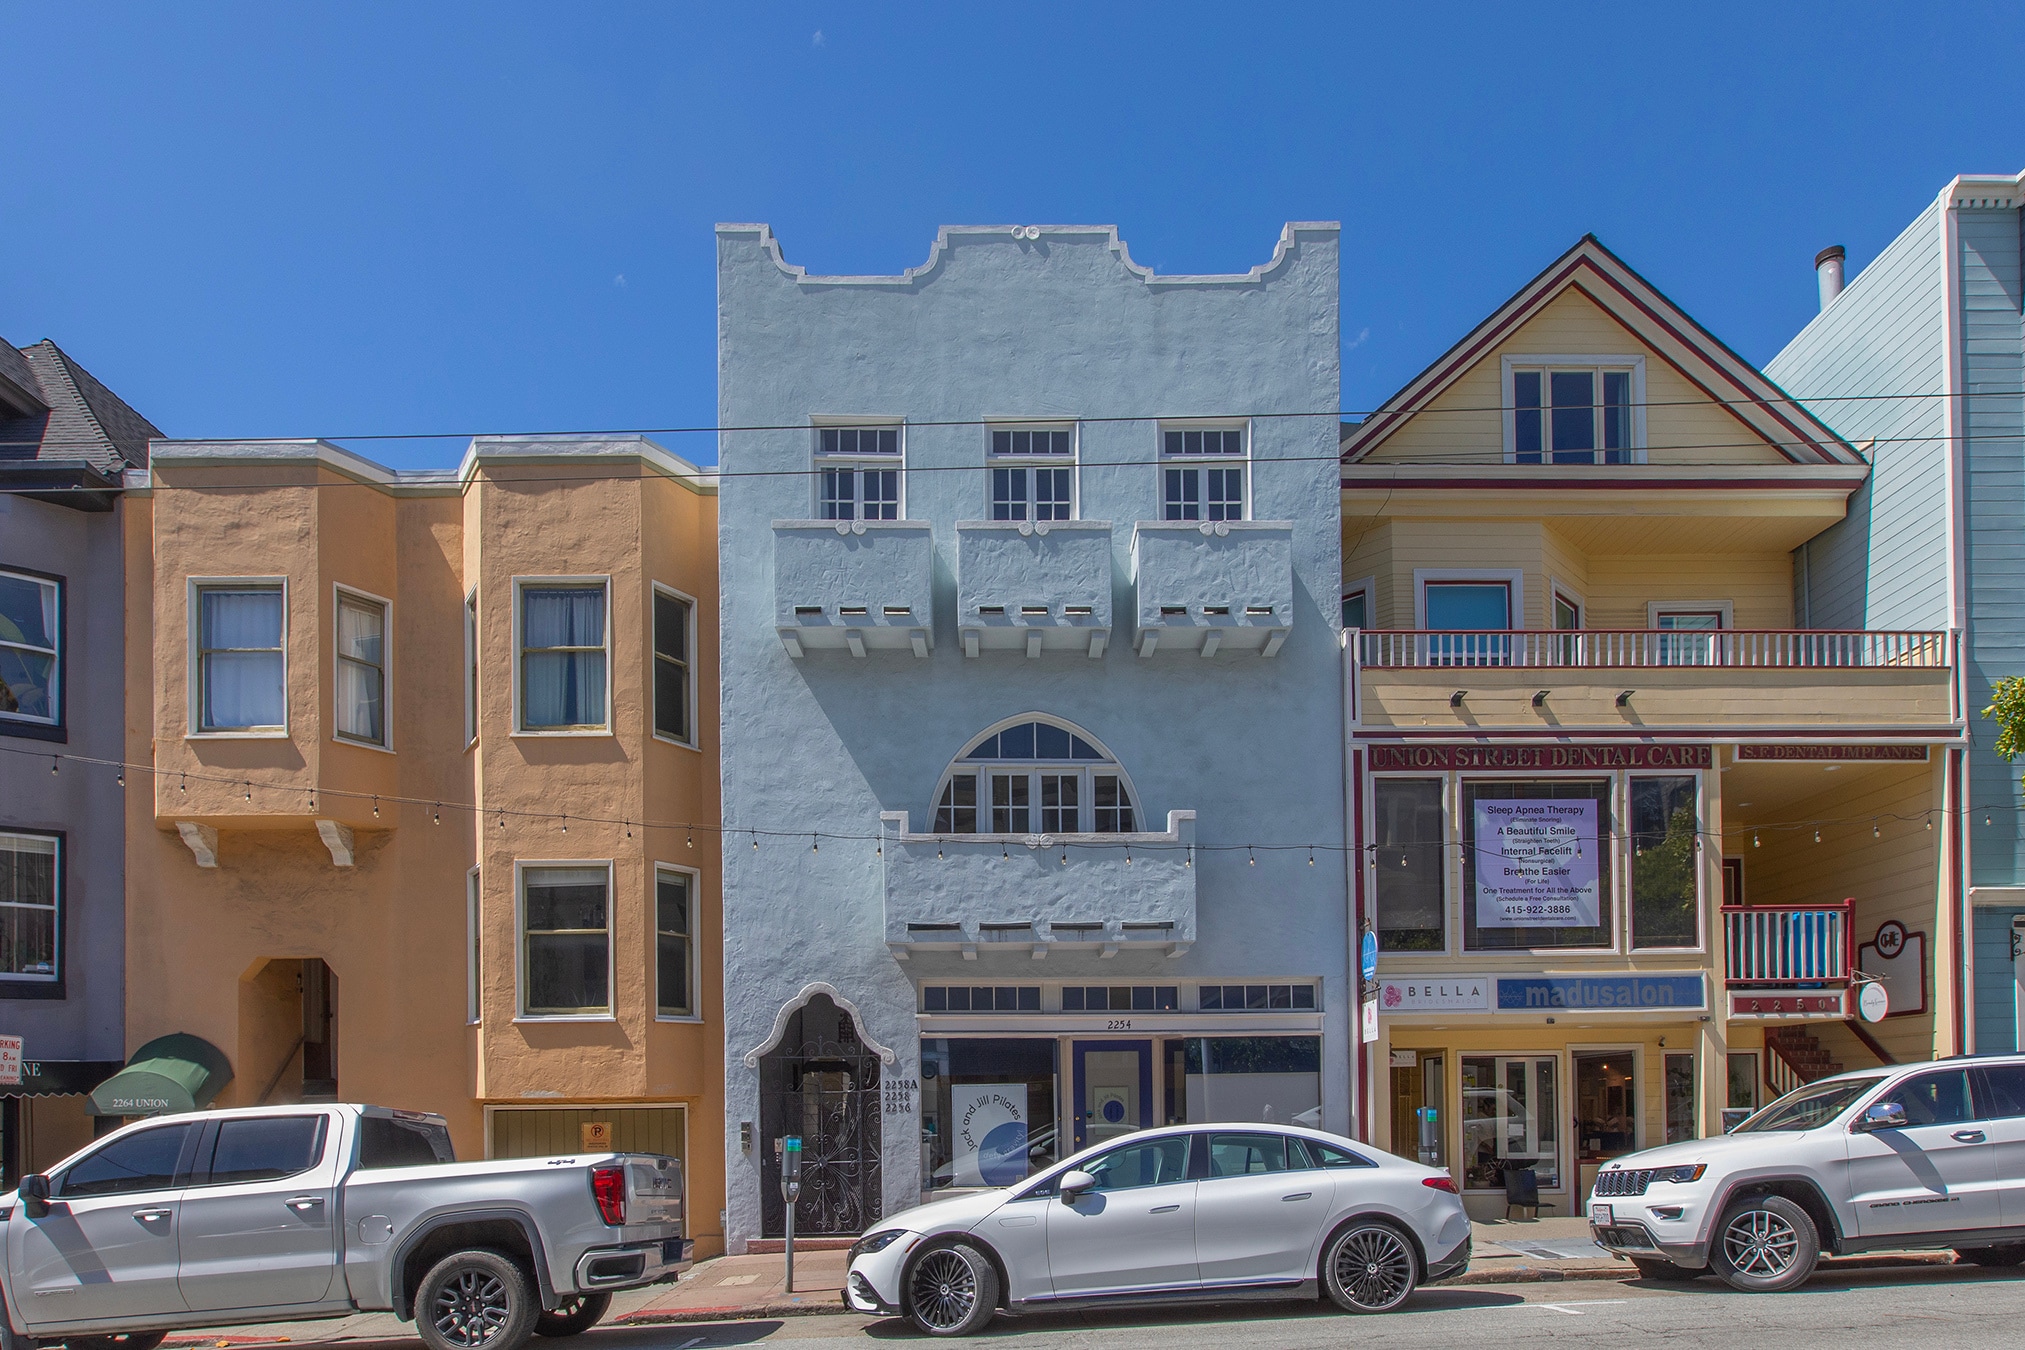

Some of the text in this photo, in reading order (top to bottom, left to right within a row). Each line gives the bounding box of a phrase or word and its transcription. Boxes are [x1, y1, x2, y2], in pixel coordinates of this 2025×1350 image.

[1372, 746, 1711, 767] UNION STREET DENTAL CARE
[1773, 746, 1837, 758] DENTAL
[1841, 746, 1922, 758] IMPLANTS
[1487, 805, 1584, 816] Sleep Apnea Therapy
[1497, 827, 1576, 835] A Beautiful Smile
[1501, 847, 1572, 855] Internal Facelift
[1503, 867, 1570, 876] Breathe Easier
[1505, 905, 1571, 914] 415-922-3886
[1408, 986, 1480, 996] BELLA
[1525, 979, 1674, 1006] madusalon
[1108, 1020, 1131, 1029] 2254
[885, 1079, 918, 1090] 2258A
[885, 1091, 910, 1101] 2258
[113, 1098, 169, 1108] 2264 UNION
[885, 1103, 911, 1113] 2256
[960, 1094, 1021, 1152] Jack and Jill Pilates
